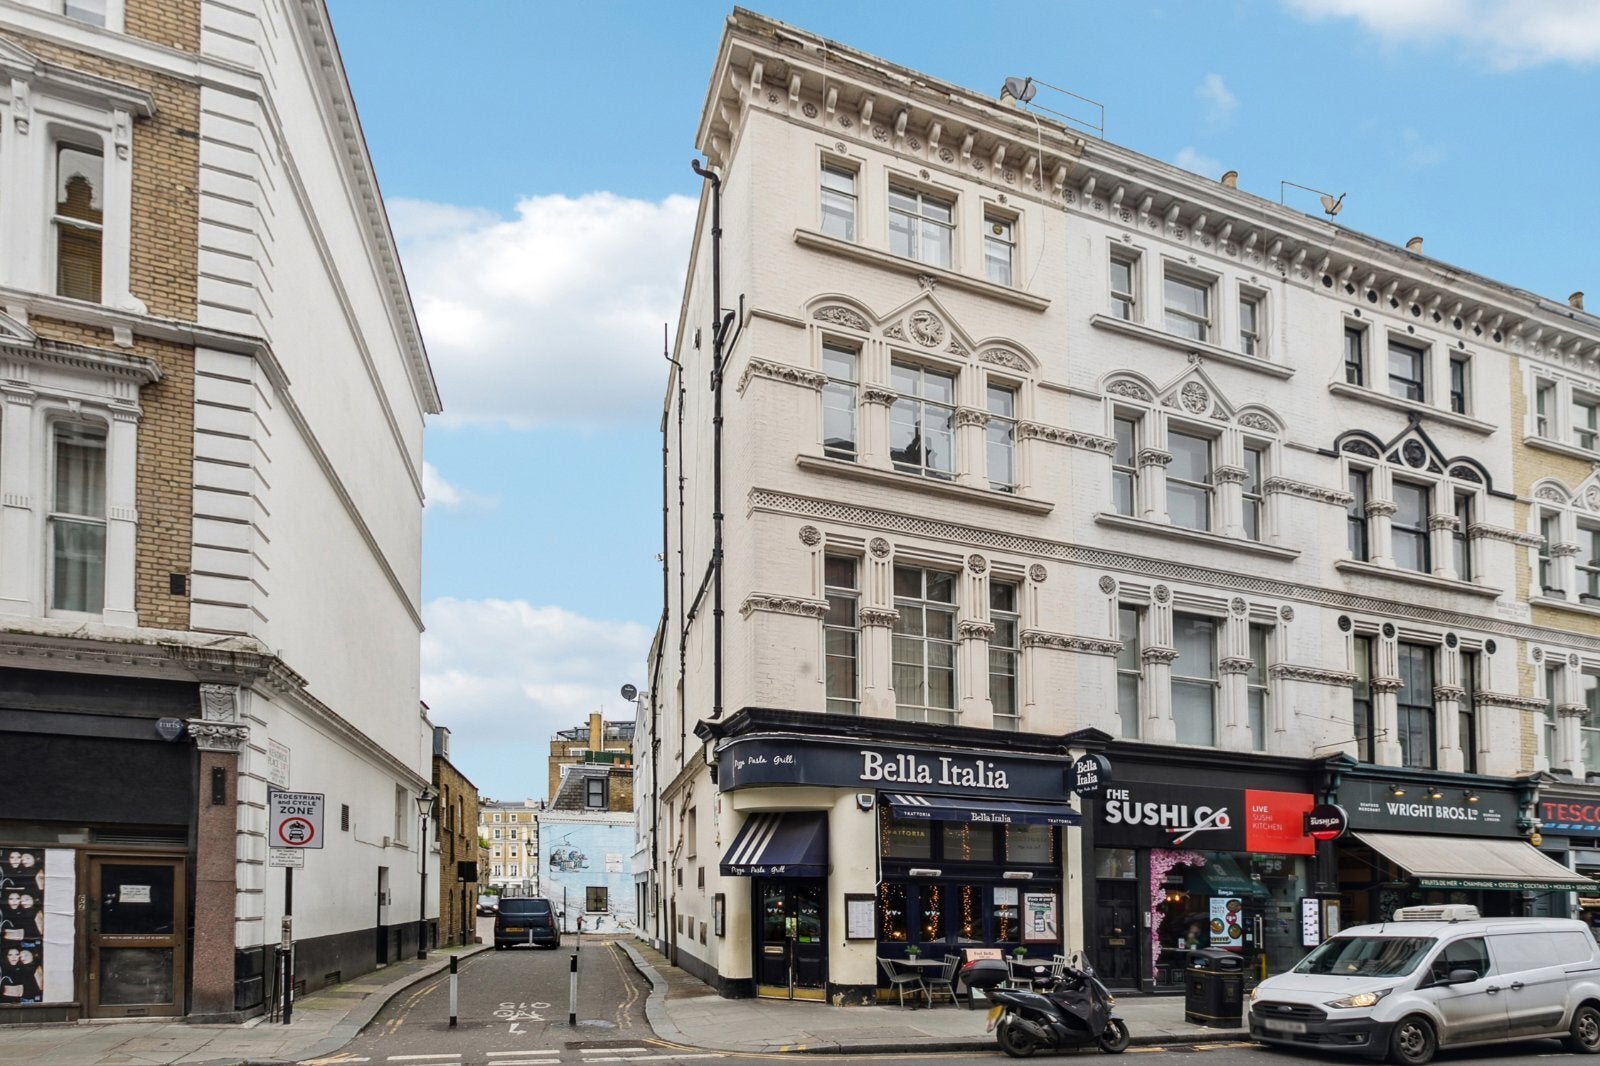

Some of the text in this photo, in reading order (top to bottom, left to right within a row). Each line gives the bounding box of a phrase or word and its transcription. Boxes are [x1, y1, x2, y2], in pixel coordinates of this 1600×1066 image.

[748, 755, 768, 765] Pasta
[773, 754, 794, 766] Grill
[860, 750, 1009, 789] Bella Italia
[1076, 759, 1098, 774] Bella
[1076, 773, 1098, 786] Italia
[273, 793, 321, 801] PEDESTRIAN
[1106, 788, 1130, 800] THE
[280, 806, 314, 815] ZONE
[1105, 800, 1188, 827] SUSHI
[1252, 805, 1269, 813] LIVE
[1386, 802, 1434, 818] WRIGHT
[971, 812, 991, 822] Bella
[991, 813, 1012, 823] Italia
[1252, 814, 1273, 822] SUSHI
[1310, 818, 1330, 826] SUSHI
[1252, 822, 1283, 831] KITCHEN
[750, 865, 766, 874] Pasta
[770, 865, 786, 875] Grill
